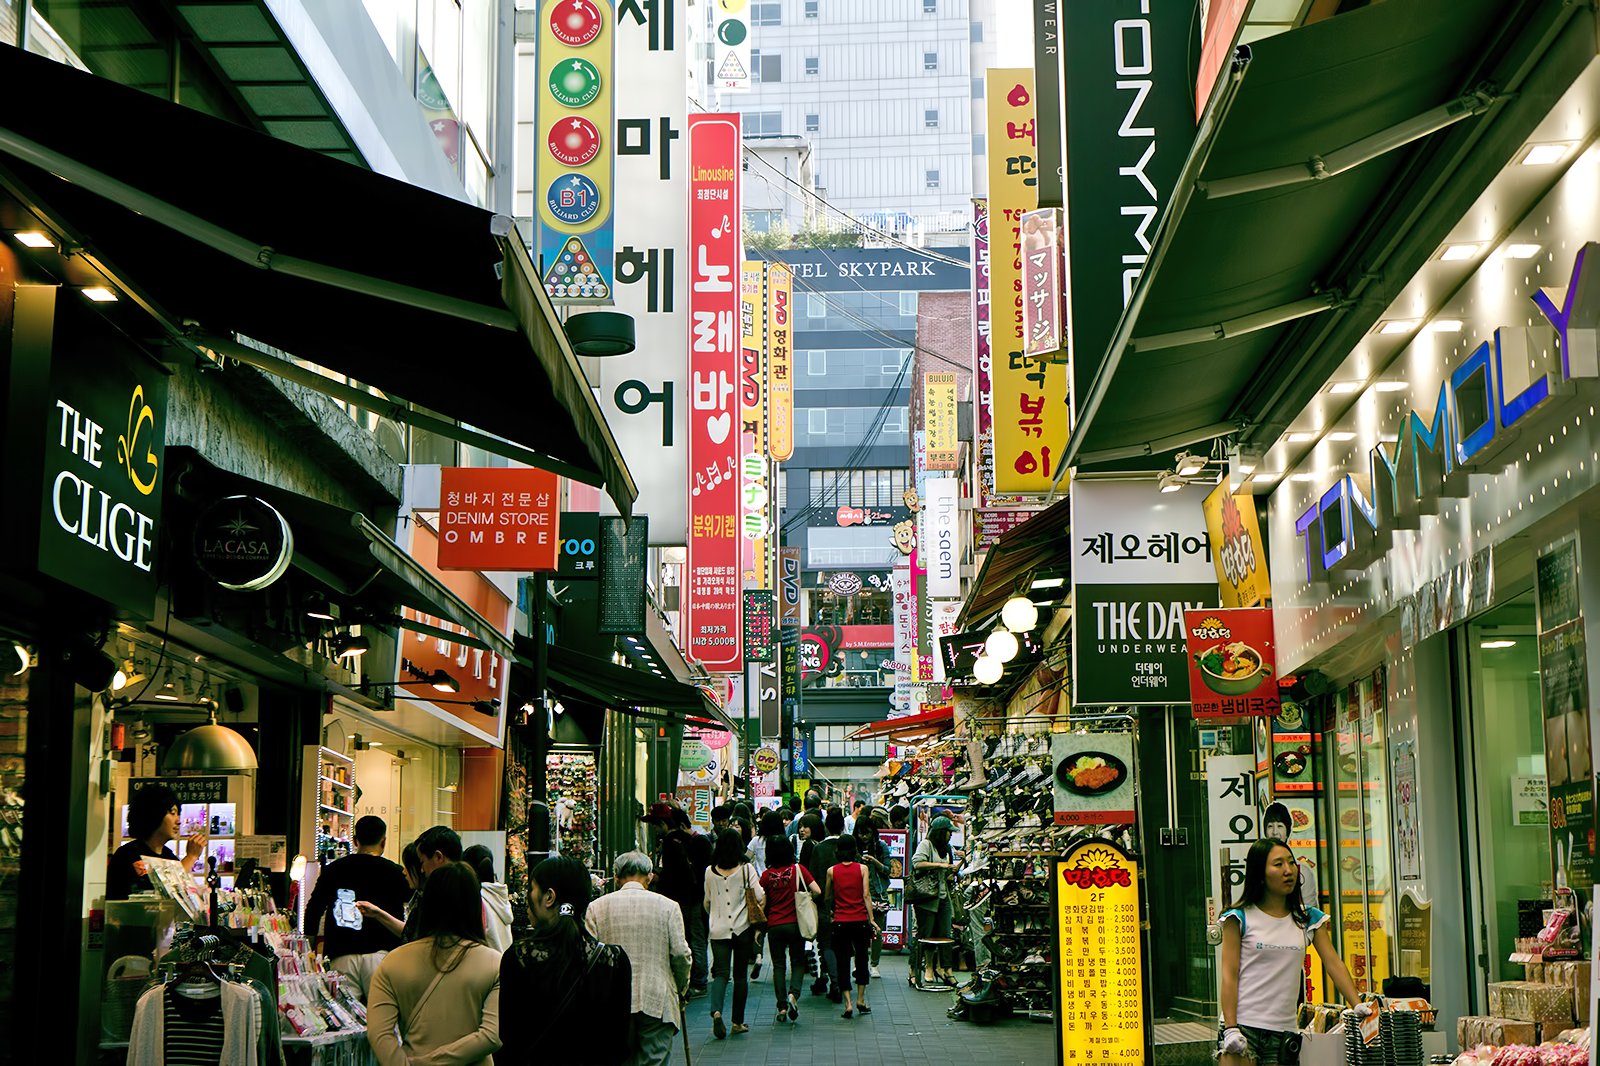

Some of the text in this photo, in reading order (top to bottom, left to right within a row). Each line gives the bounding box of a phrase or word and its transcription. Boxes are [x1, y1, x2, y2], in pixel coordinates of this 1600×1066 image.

[551, 22, 599, 42] BILLIARD CLUB
[550, 83, 598, 103] BILLIARD CLUB
[549, 142, 597, 162] BILLIARD CLUB
[692, 165, 734, 182] Limousine
[560, 189, 587, 207] B1
[549, 199, 597, 220] BILLIARD CLUB
[839, 260, 936, 277] SKYPARK
[1029, 251, 1050, 341] マッサージ
[774, 290, 788, 325] DVD
[773, 329, 789, 380] 영화관
[742, 347, 760, 408] DVD
[1295, 241, 1590, 584] TONYMOLY
[56, 399, 104, 469] THE
[447, 491, 550, 508] 청바지 전문샵
[52, 470, 154, 573] CLIGE
[446, 511, 549, 526] DENIM STORE
[445, 530, 548, 545] OMBRE
[937, 495, 954, 580] the saem
[203, 539, 270, 555] LACASA
[1081, 531, 1212, 564] 제오헤어
[574, 560, 596, 571] 크루
[780, 556, 800, 606] DVD
[1092, 601, 1204, 640] THE DA
[1135, 662, 1163, 675] 더데이
[1131, 675, 1168, 688] 언더웨어
[1220, 697, 1282, 715] 냄비국수
[757, 755, 776, 764] DVD
[695, 788, 708, 822] ミナミ
[1060, 814, 1080, 822] 4,000
[1090, 892, 1105, 902] 2F
[1114, 904, 1134, 913] 2,500
[1065, 914, 1134, 924] 참치김밥 2,500
[1065, 925, 1135, 935] 떡볶이 2,500
[1115, 936, 1136, 945] 3,000
[1066, 946, 1136, 956] 손만두 3,500
[1066, 957, 1136, 967] 비빔냉면 4,000
[1116, 968, 1137, 976] 4,000
[1067, 978, 1137, 988] 비빔밥 4,000
[1067, 989, 1138, 999] 냄비국수 4,000
[1068, 1000, 1138, 1009] 생우동 3,500
[1068, 1010, 1139, 1020] 김치우동 4,000
[1068, 1021, 1139, 1031] 돈까스 4,000
[1069, 1049, 1140, 1059] 물냉면 4,000
